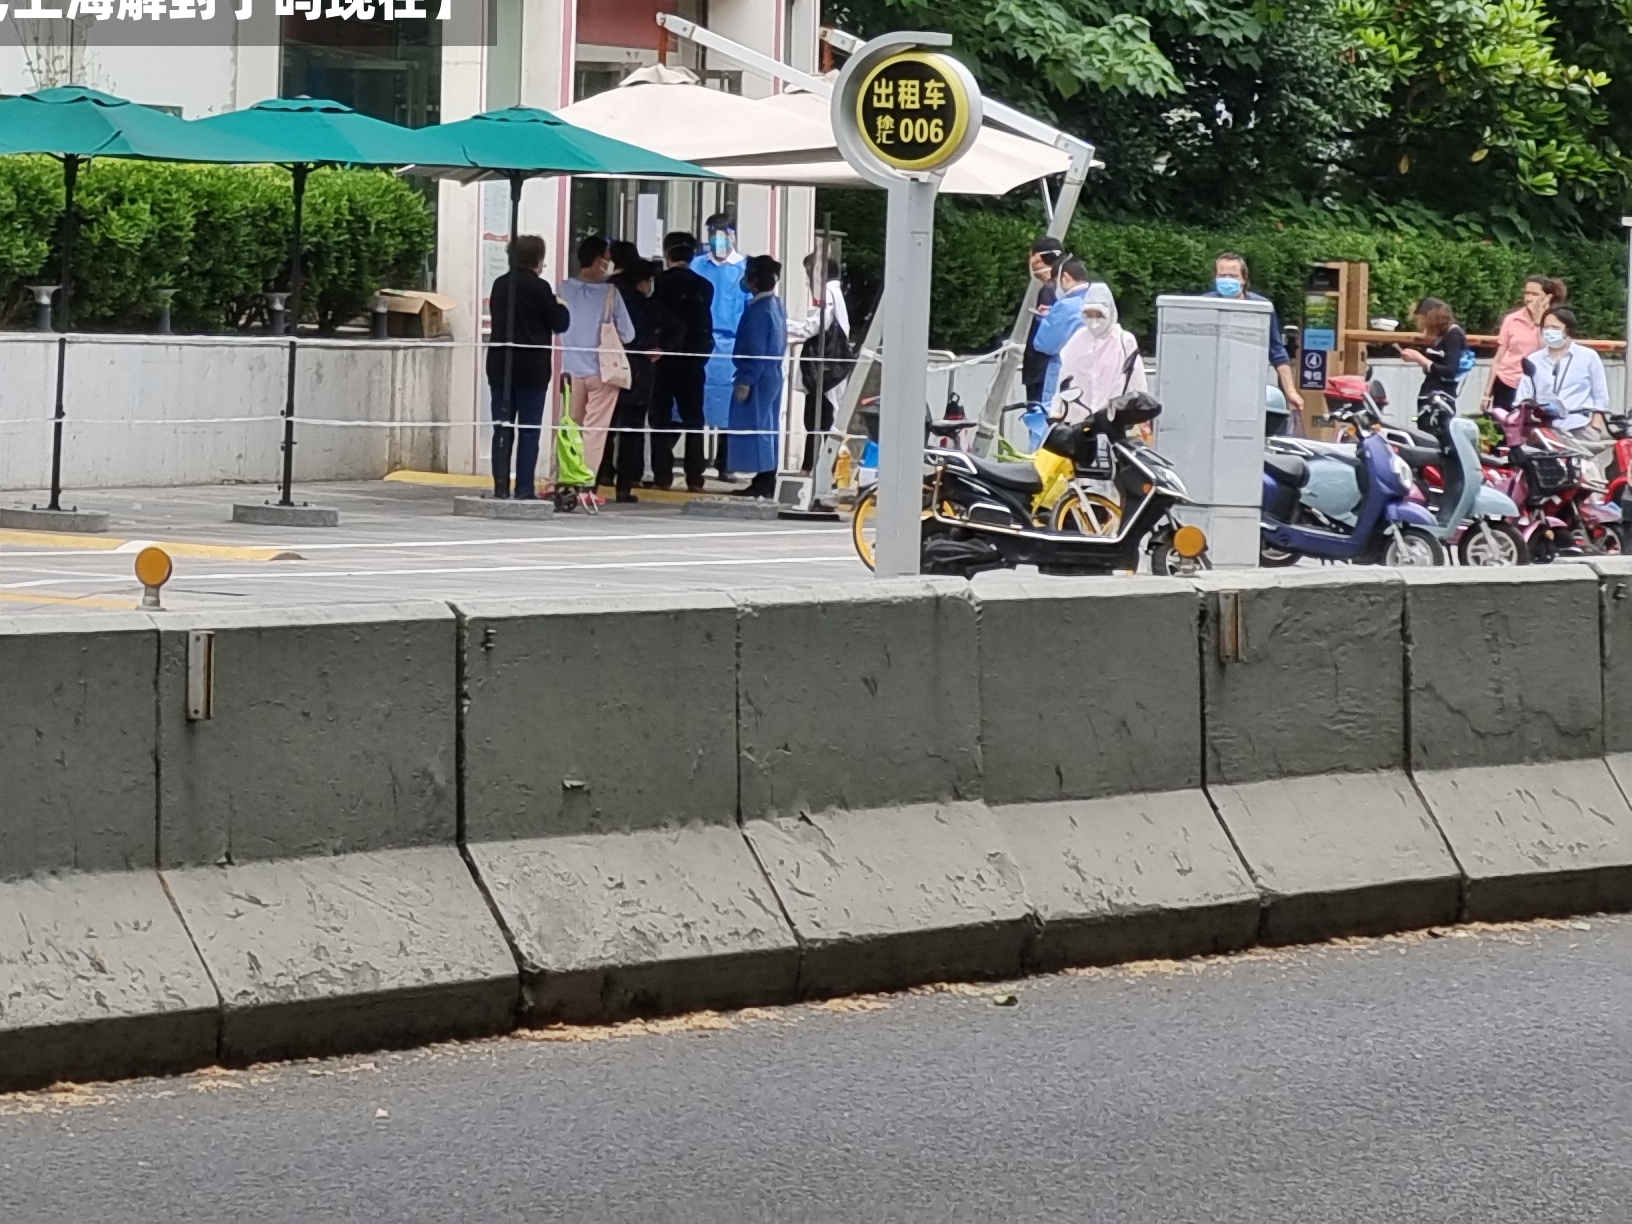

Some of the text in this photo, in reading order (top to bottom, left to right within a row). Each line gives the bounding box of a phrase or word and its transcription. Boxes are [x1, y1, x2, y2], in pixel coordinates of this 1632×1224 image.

[873, 77, 946, 111] 出租车
[899, 117, 945, 144] 006
